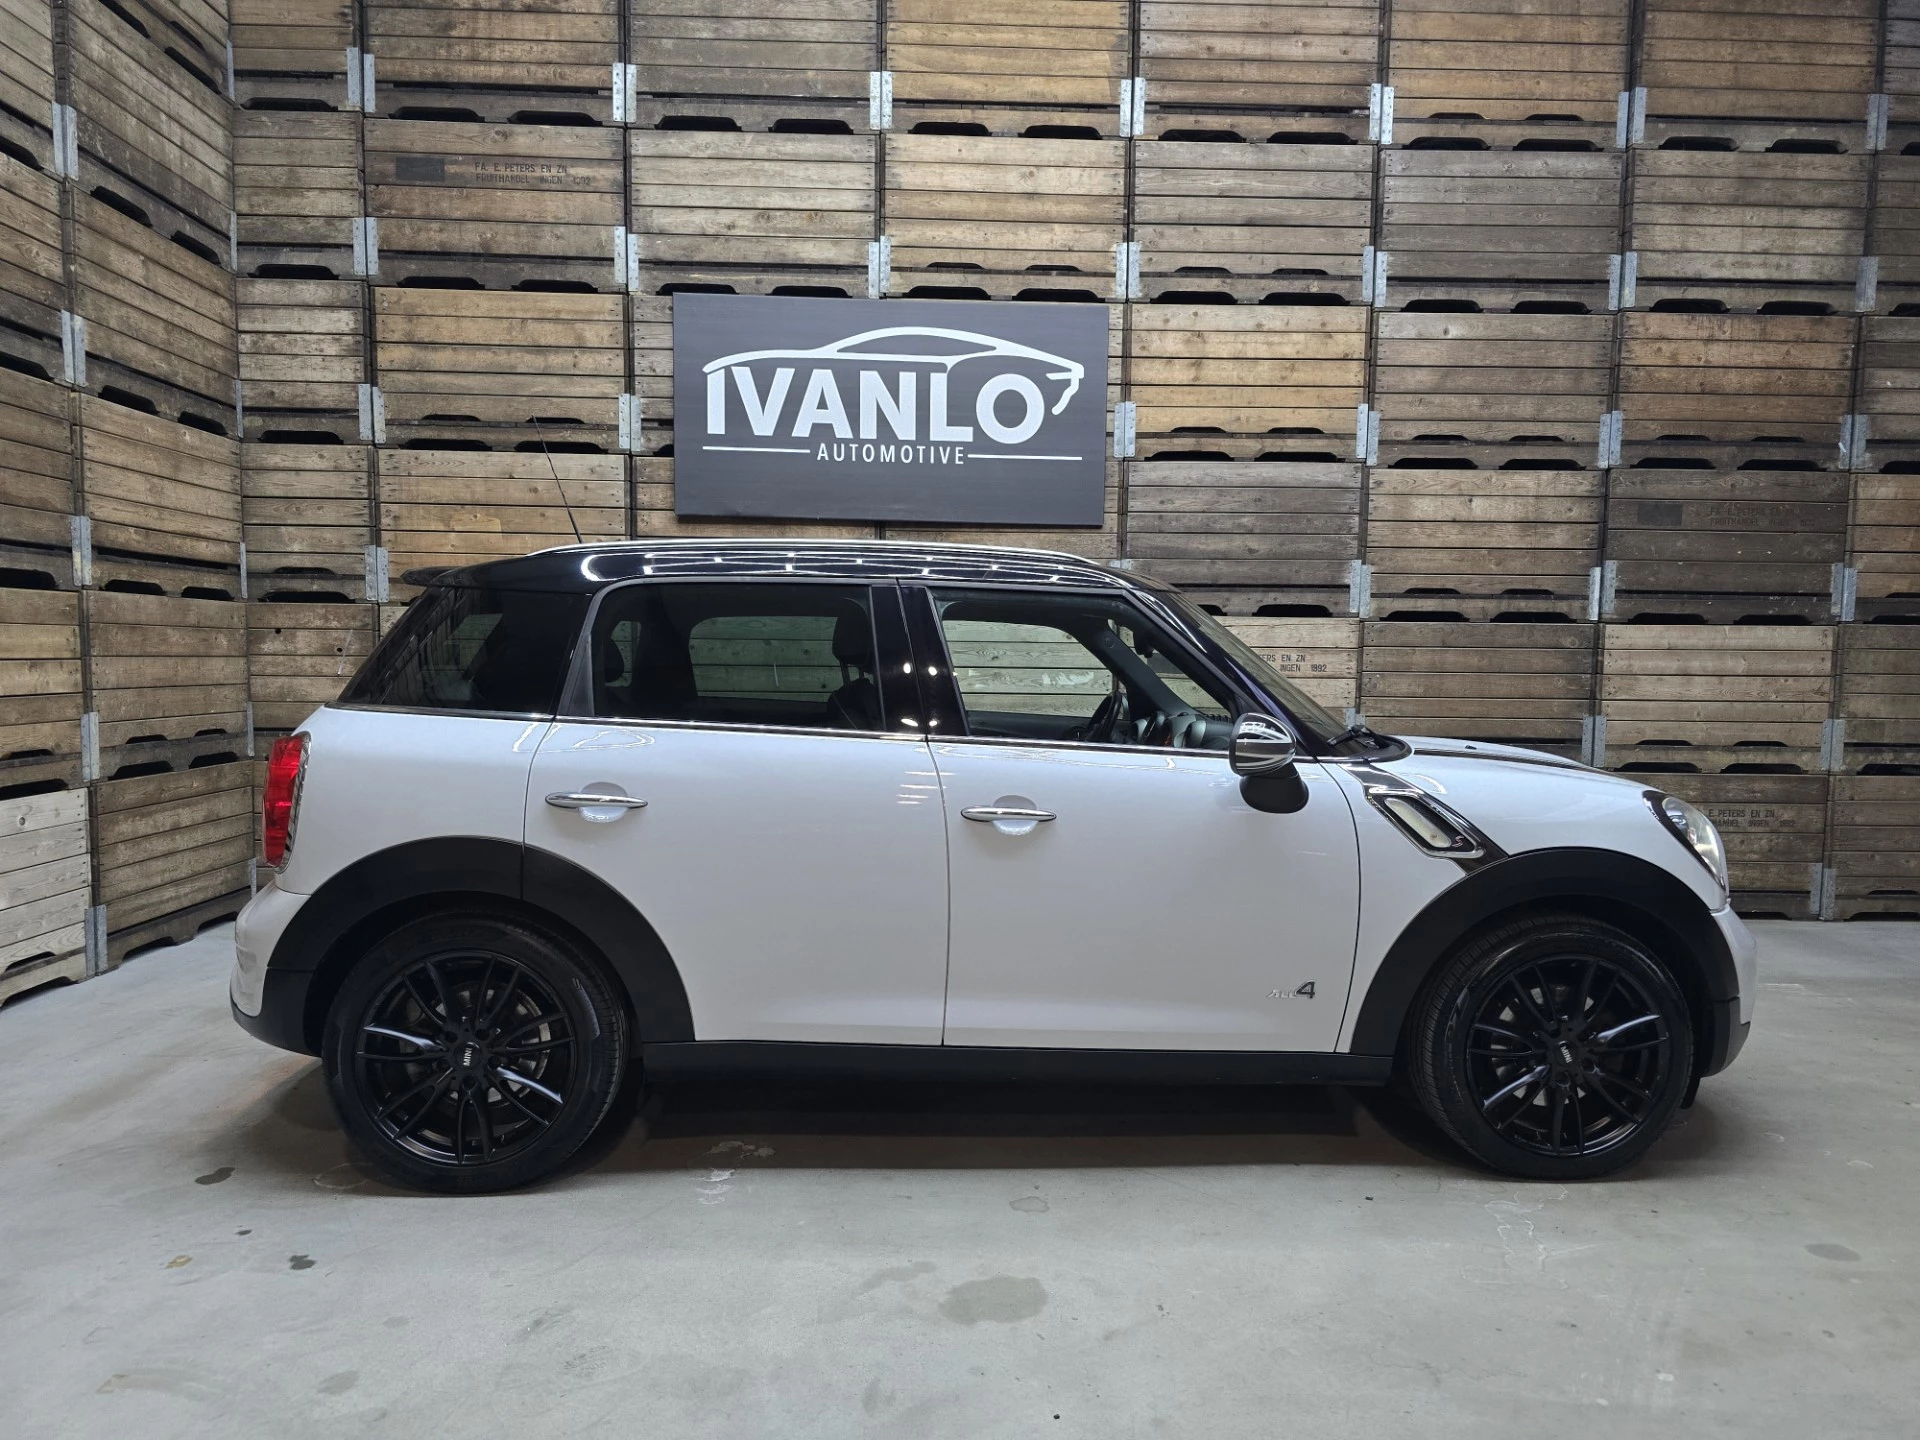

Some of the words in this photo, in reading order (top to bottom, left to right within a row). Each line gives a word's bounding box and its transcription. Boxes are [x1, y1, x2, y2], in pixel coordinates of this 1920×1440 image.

[504, 163, 536, 173] PETERS
[541, 164, 552, 173] EN
[557, 165, 568, 174] ZN
[475, 173, 530, 183] FRUITHANDEL
[707, 365, 1046, 445] IVANLO
[816, 443, 965, 465] AUTOMOTIVE
[1281, 654, 1291, 662] EN
[1296, 654, 1306, 662] ZN
[1280, 664, 1301, 672] INGEN
[1311, 664, 1328, 673] 1992
[1719, 809, 1746, 818] PETERS
[1750, 810, 1760, 818] EN
[1765, 810, 1775, 818] ZN
[463, 1047, 473, 1067] MINI
[1560, 1045, 1573, 1064] MINI
